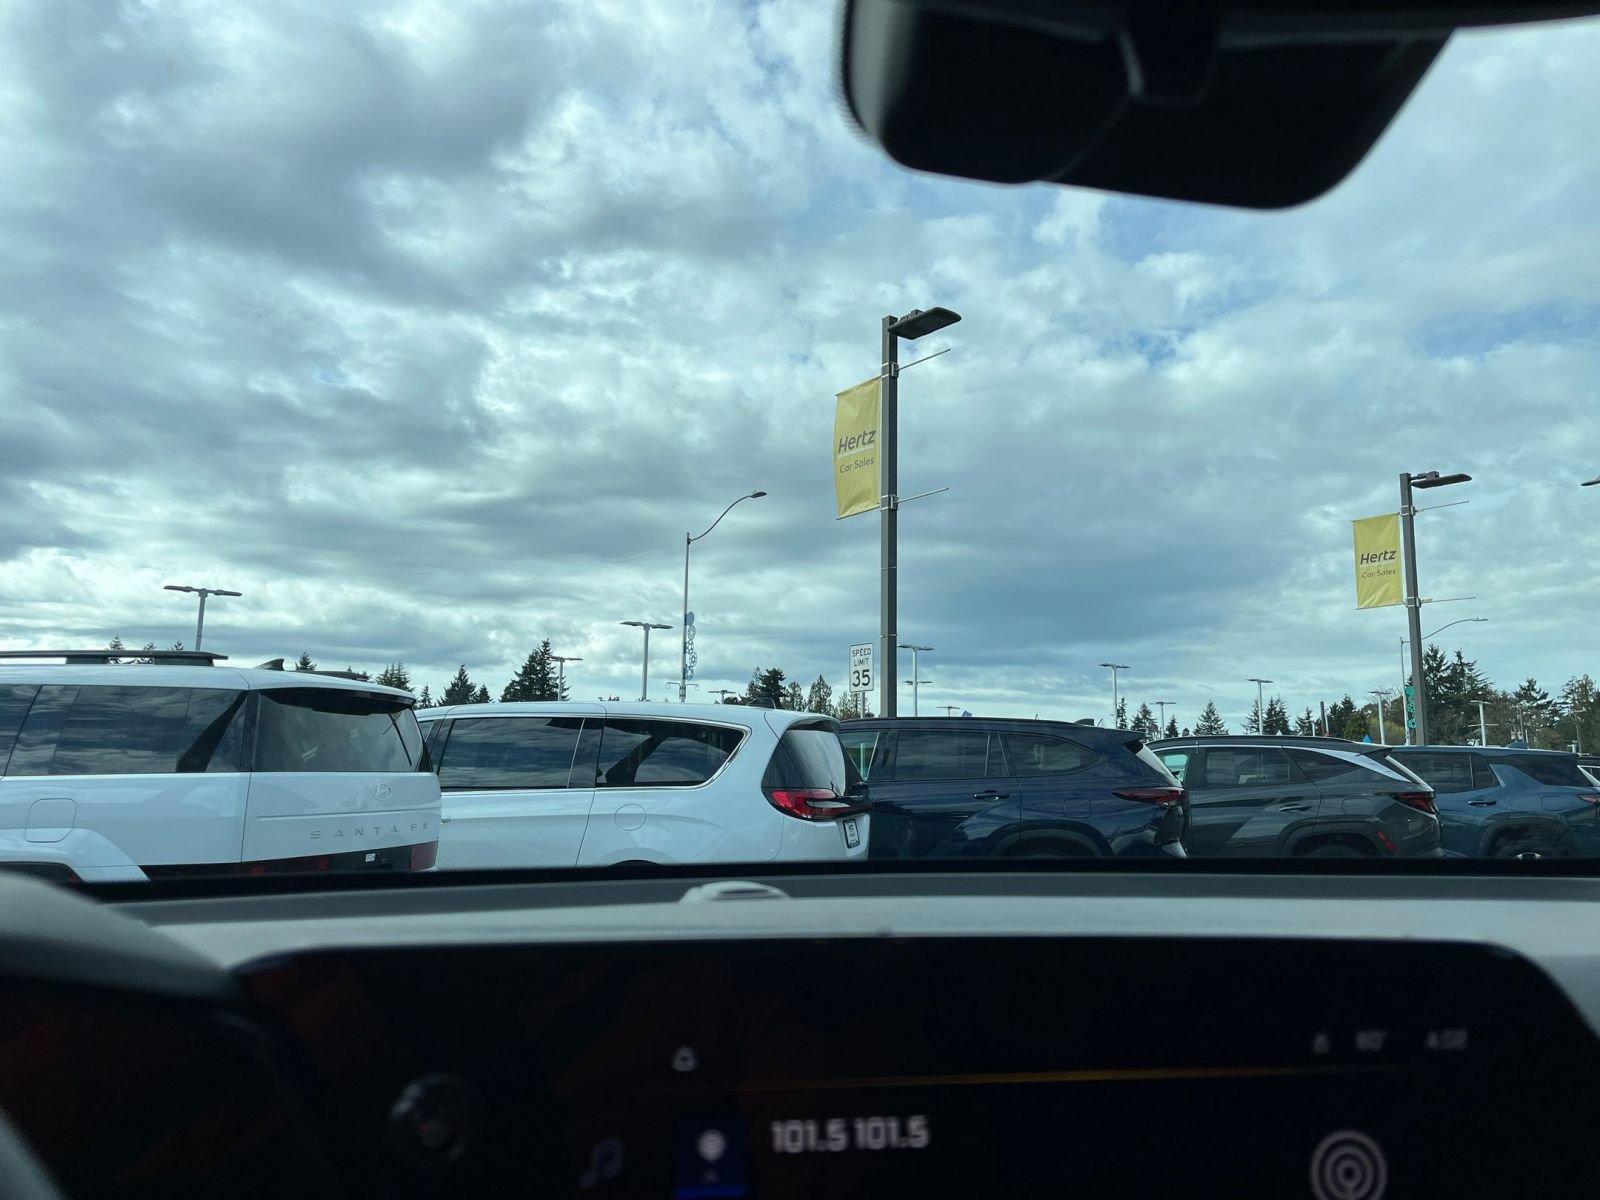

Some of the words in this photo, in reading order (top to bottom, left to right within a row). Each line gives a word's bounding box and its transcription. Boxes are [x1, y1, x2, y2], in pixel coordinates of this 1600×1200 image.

[838, 430, 877, 454] Hertz
[840, 464, 853, 473] Car
[854, 457, 874, 469] Sales
[1360, 550, 1397, 564] Hertz
[1377, 569, 1396, 577] Sales
[852, 648, 871, 657] SPEED
[854, 658, 869, 666] LIMIT
[852, 669, 871, 687] 35
[310, 826, 398, 839] SANTA
[410, 821, 429, 832] FE
[771, 1119, 847, 1154] 101.5
[853, 1114, 930, 1150] 101.5
